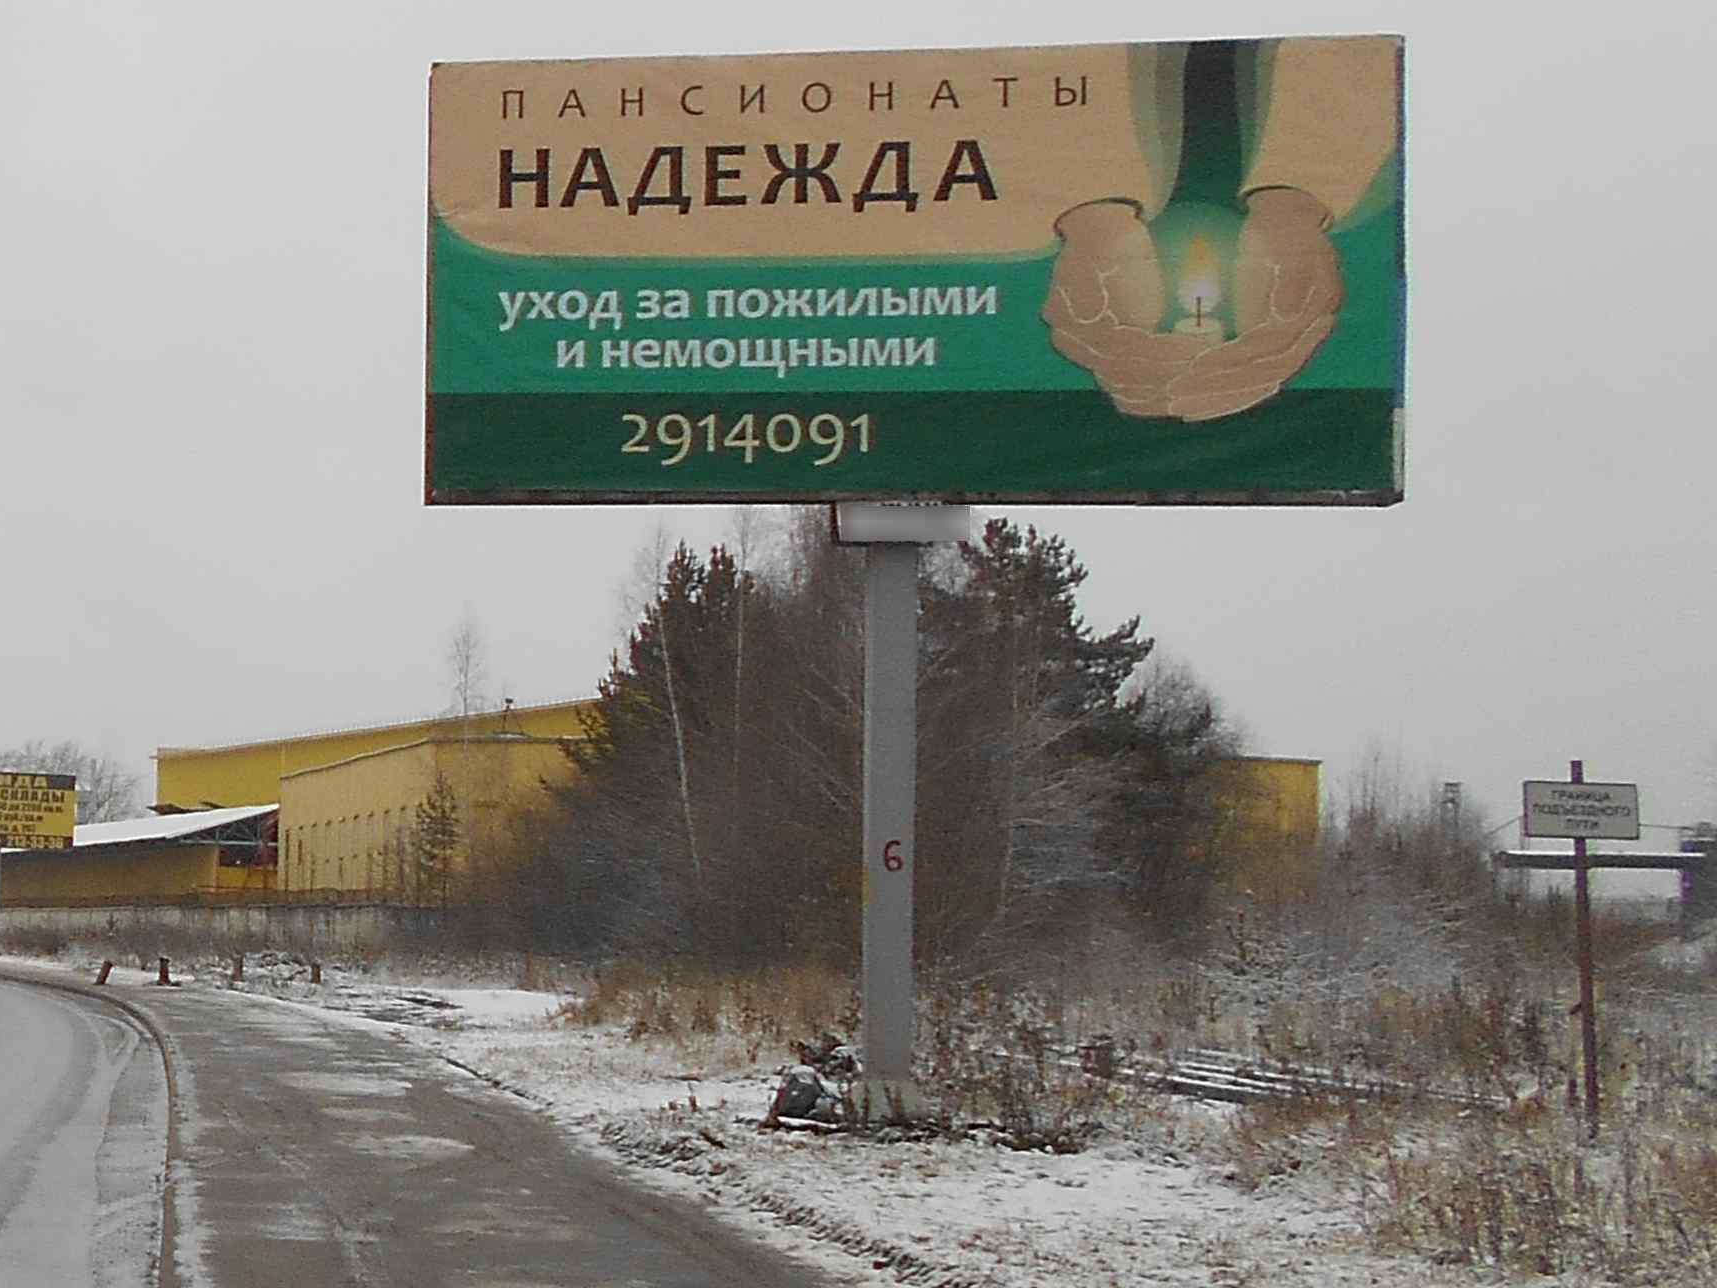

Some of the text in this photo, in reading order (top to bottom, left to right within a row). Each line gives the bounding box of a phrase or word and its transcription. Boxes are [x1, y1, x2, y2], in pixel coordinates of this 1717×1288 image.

[500, 76, 1088, 120] ПАНСИОНАТЫ
[497, 139, 999, 216] НАДЕЖДА
[498, 285, 999, 331] уход за пожилыми
[555, 334, 938, 379] и немощными
[621, 412, 874, 467] 2914091
[884, 839, 903, 872] 6
